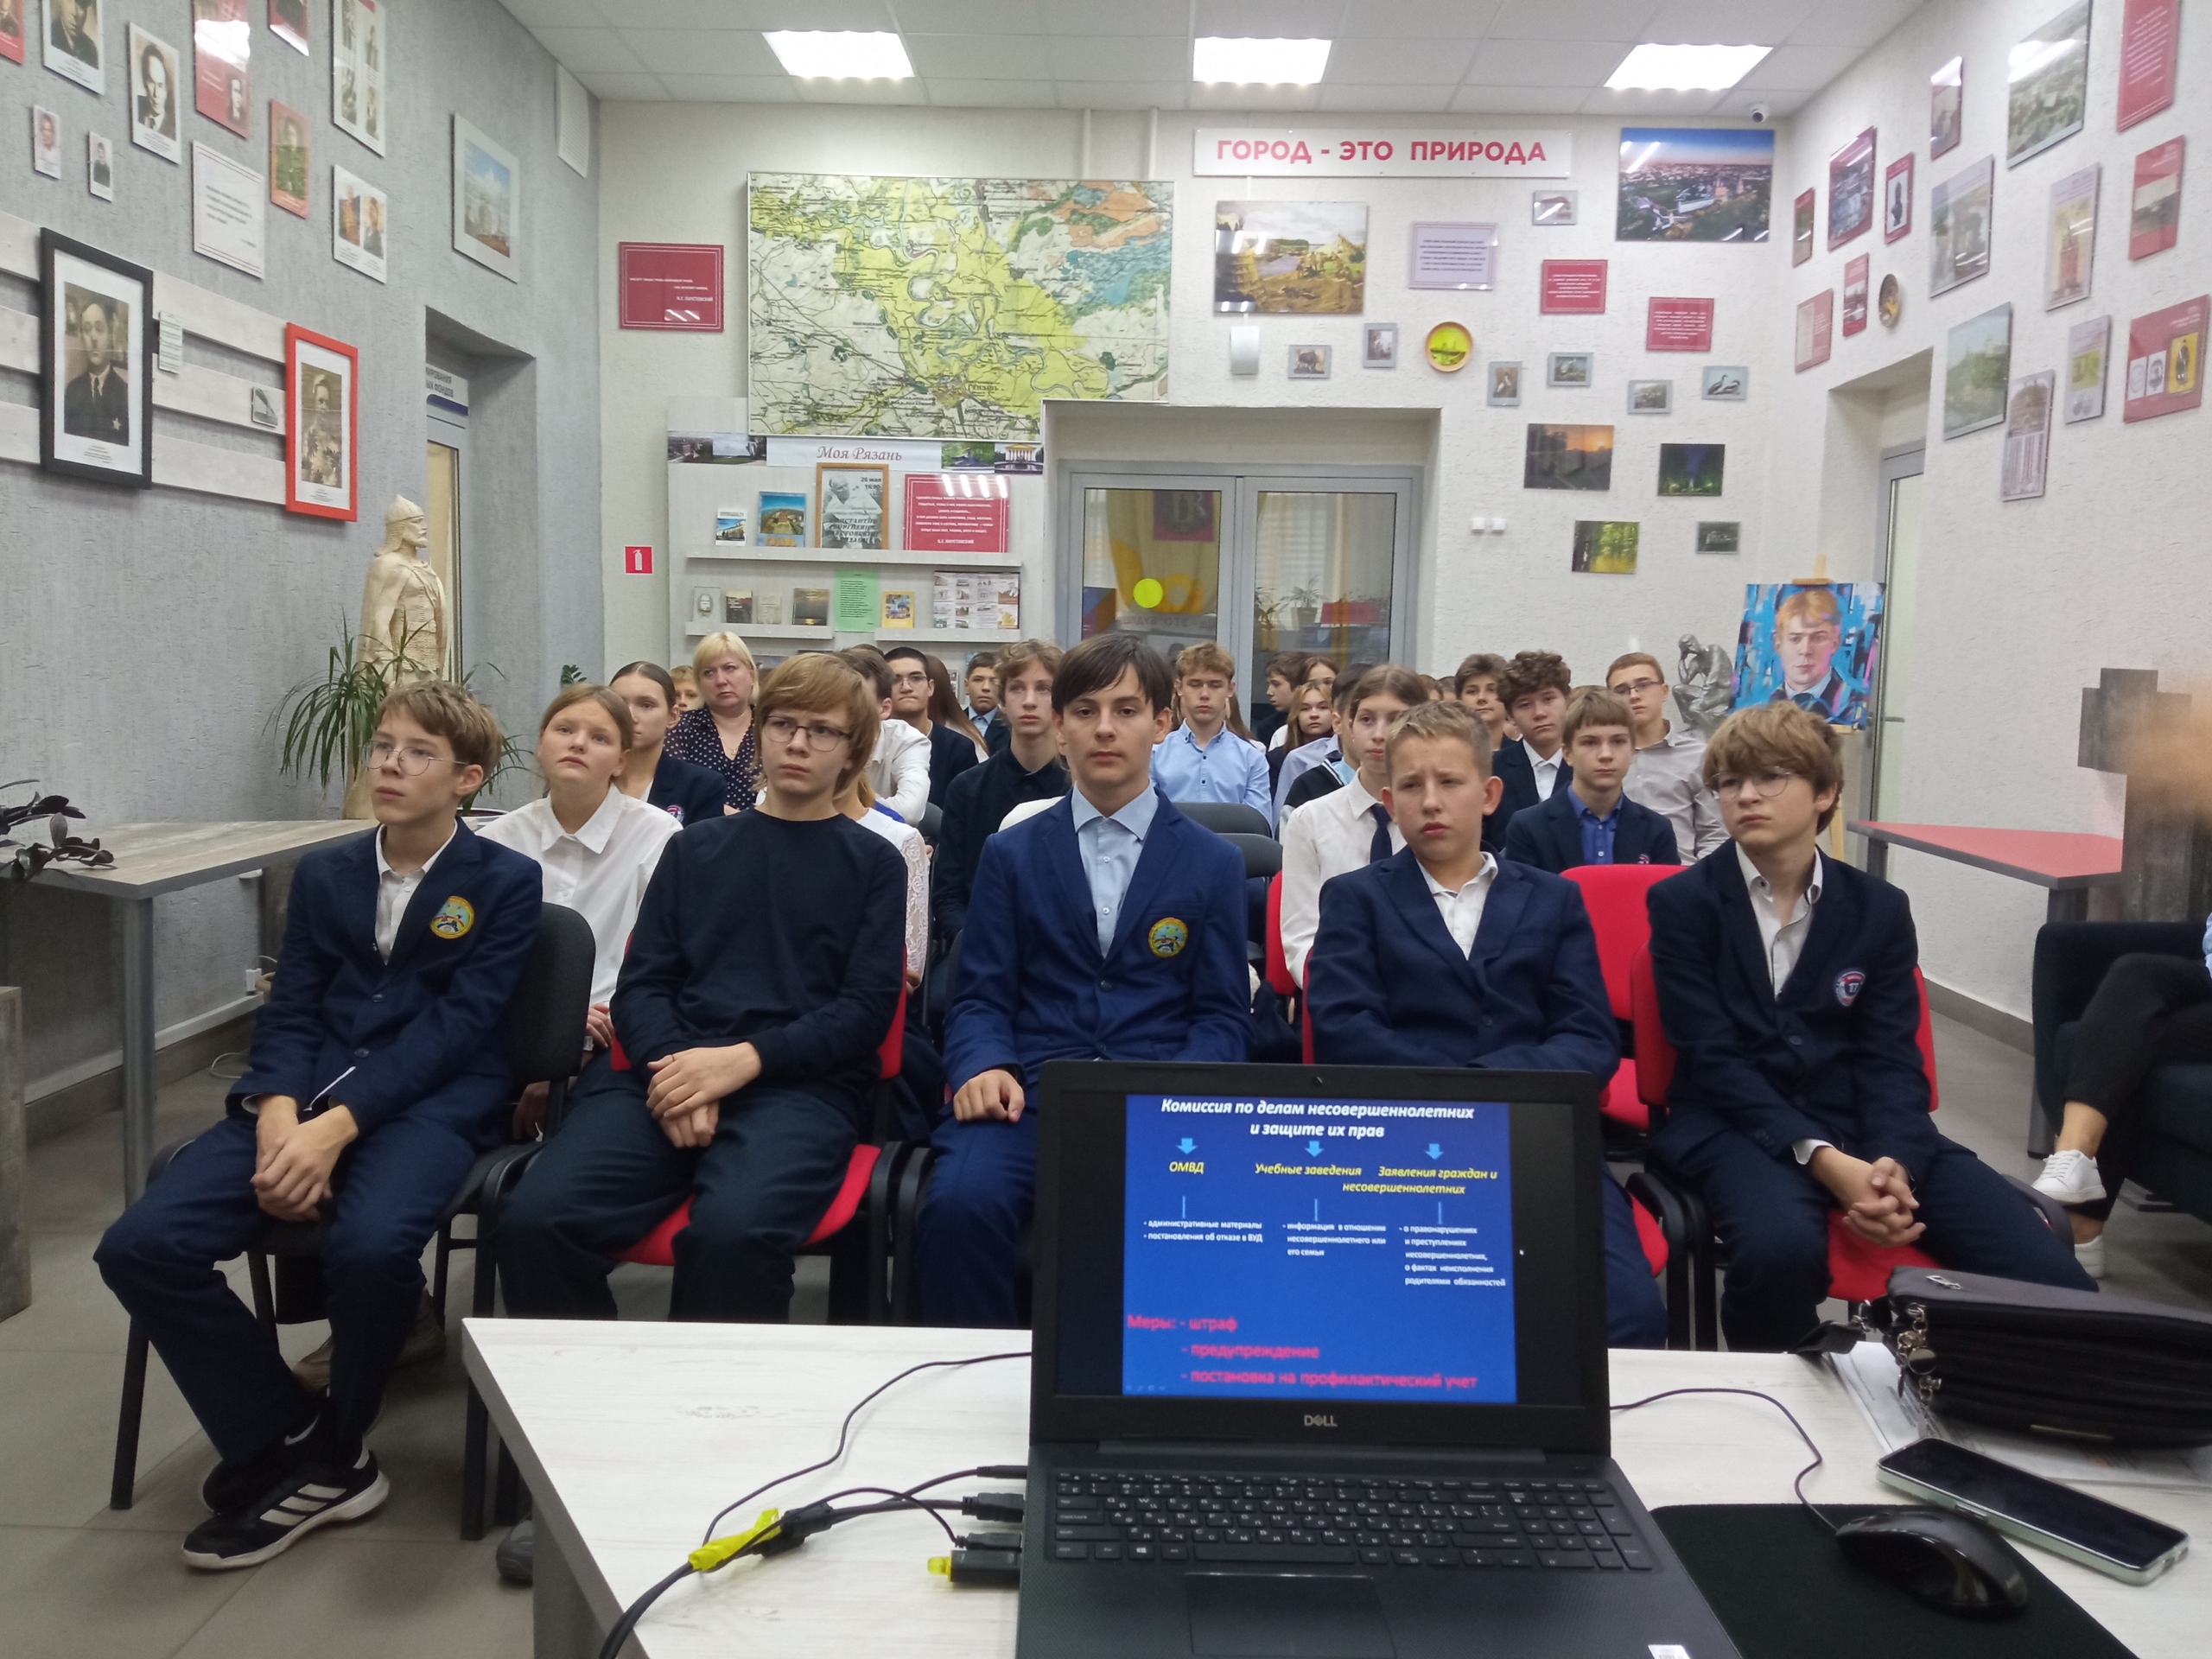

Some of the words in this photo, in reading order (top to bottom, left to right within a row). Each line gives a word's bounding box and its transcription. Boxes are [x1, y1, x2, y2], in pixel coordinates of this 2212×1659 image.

[1217, 140, 1312, 164] ГОРОД
[1338, 140, 1394, 162] ЭТО
[1410, 141, 1547, 165] ПРИРОДА
[817, 446, 849, 459] Моя
[852, 447, 902, 461] Рязань
[1161, 1098, 1232, 1114] Комиссия
[1235, 1103, 1254, 1114] по
[1256, 1100, 1304, 1115] делам
[1307, 1103, 1475, 1119] несовершеннолетних
[1249, 1124, 1260, 1135] и
[1262, 1124, 1325, 1138] защите
[1327, 1126, 1344, 1136] их
[1348, 1126, 1385, 1140] прав
[1168, 1161, 1205, 1174] ОМВД
[1255, 1163, 1303, 1175] Учебные
[1304, 1164, 1363, 1176] заведения
[1378, 1166, 1436, 1177] Заявления
[1438, 1168, 1488, 1180] граждан
[1490, 1171, 1498, 1179] и
[1342, 1183, 1466, 1194] несовершеннолетних
[1148, 1219, 1219, 1229] административные
[1221, 1220, 1262, 1230] материалы
[1287, 1221, 1335, 1231] информация
[1148, 1232, 1204, 1241] постановления
[1205, 1232, 1215, 1241] об
[1248, 1234, 1263, 1243] ВУД
[1287, 1236, 1370, 1244] несовершеннолетнего
[1128, 1314, 1177, 1331] Меры:
[1189, 1316, 1238, 1332] штраф
[1191, 1344, 1320, 1359] предупреждение
[1191, 1370, 1275, 1384] постановка
[1278, 1373, 1296, 1384] на
[1300, 1370, 1442, 1388] профилактический
[1445, 1376, 1478, 1391] учет
[1304, 1414, 1338, 1427] DELL
